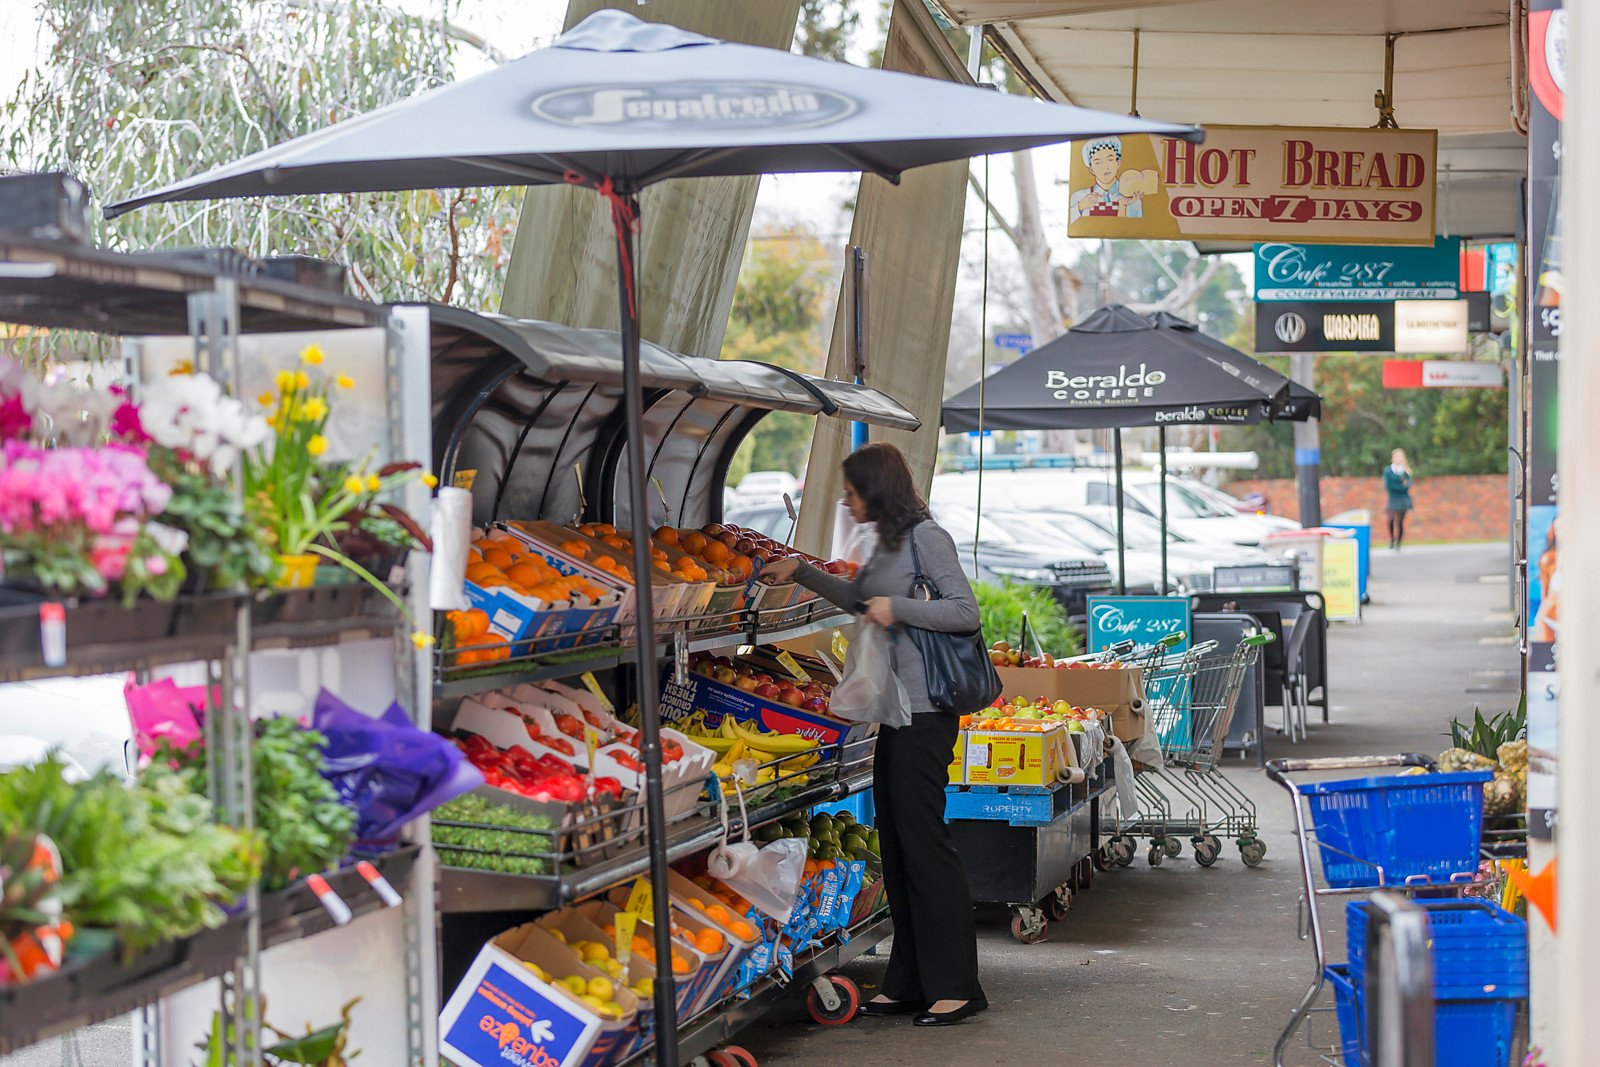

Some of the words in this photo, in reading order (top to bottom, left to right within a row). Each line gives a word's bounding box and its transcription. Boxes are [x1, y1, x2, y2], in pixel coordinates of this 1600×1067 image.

[572, 89, 818, 124] Segafredo
[1162, 138, 1257, 189] HOT
[1281, 139, 1425, 192] BREAD
[1178, 197, 1265, 218] OPEN
[1274, 197, 1306, 220] 7
[1312, 200, 1413, 221] DAYS
[1258, 242, 1332, 287] Café
[1339, 260, 1395, 282] 287
[1274, 289, 1368, 299] COURTYARD
[1368, 289, 1391, 299] AT
[1045, 363, 1167, 389] Beraldo
[1053, 386, 1154, 400] COFFEE
[1154, 405, 1206, 422] Beraldo
[1208, 407, 1248, 416] COFFEE
[1092, 604, 1141, 635] Café
[1145, 618, 1182, 633] 287
[661, 694, 692, 712] CRUNCH
[664, 682, 696, 702] FRESH
